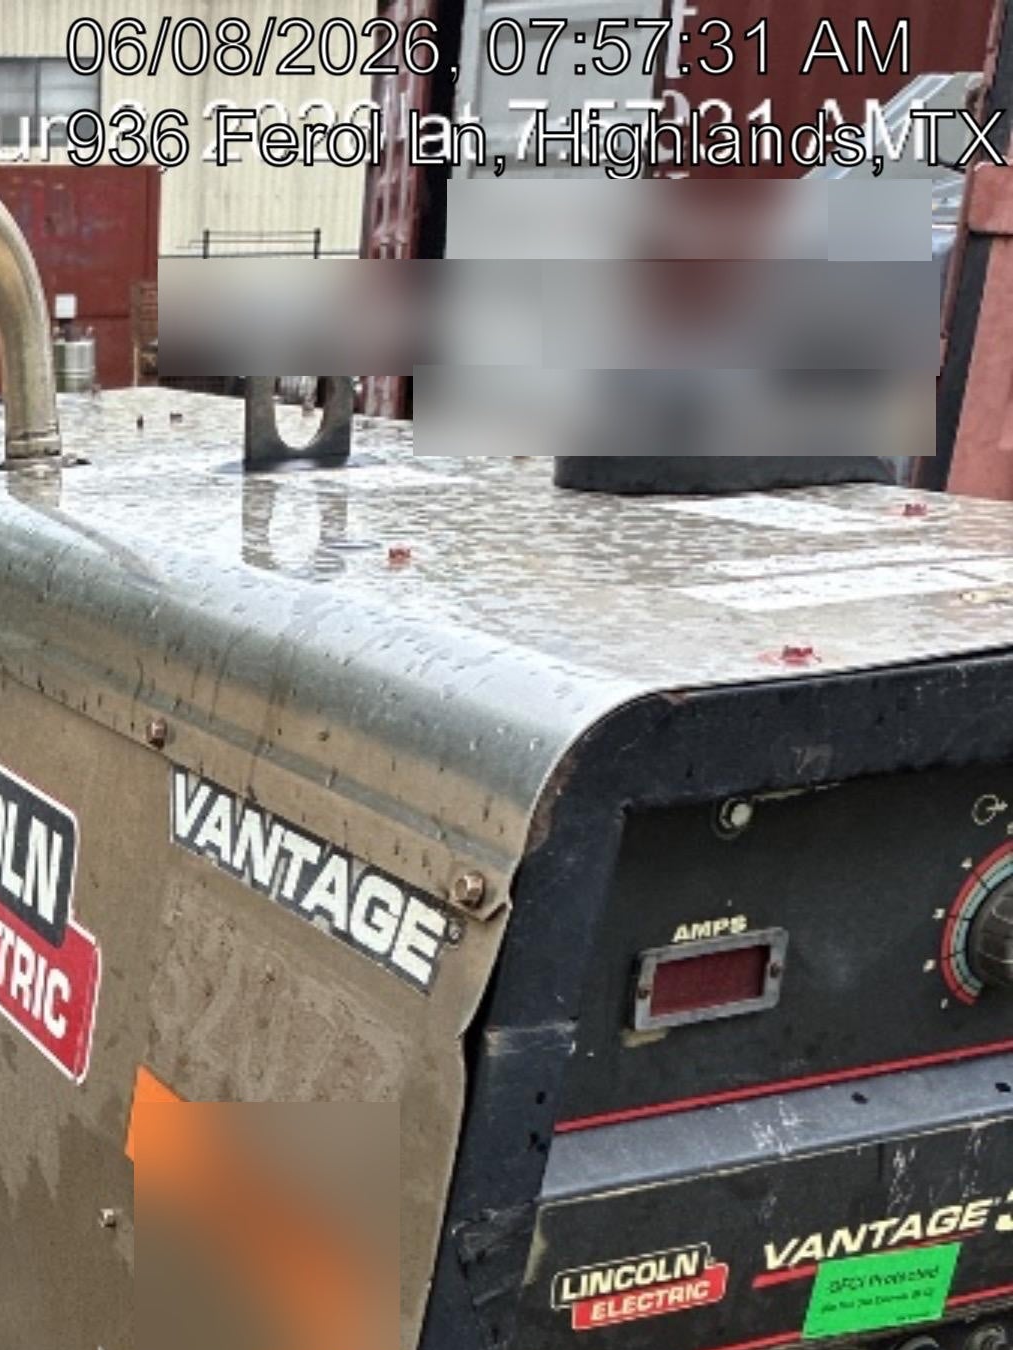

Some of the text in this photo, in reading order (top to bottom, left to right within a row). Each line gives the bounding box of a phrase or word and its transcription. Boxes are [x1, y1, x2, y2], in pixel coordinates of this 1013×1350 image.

[670, 913, 748, 944] AMPS
[561, 1250, 700, 1302] LINCOLN
[591, 1279, 711, 1321] ELECTRIC
